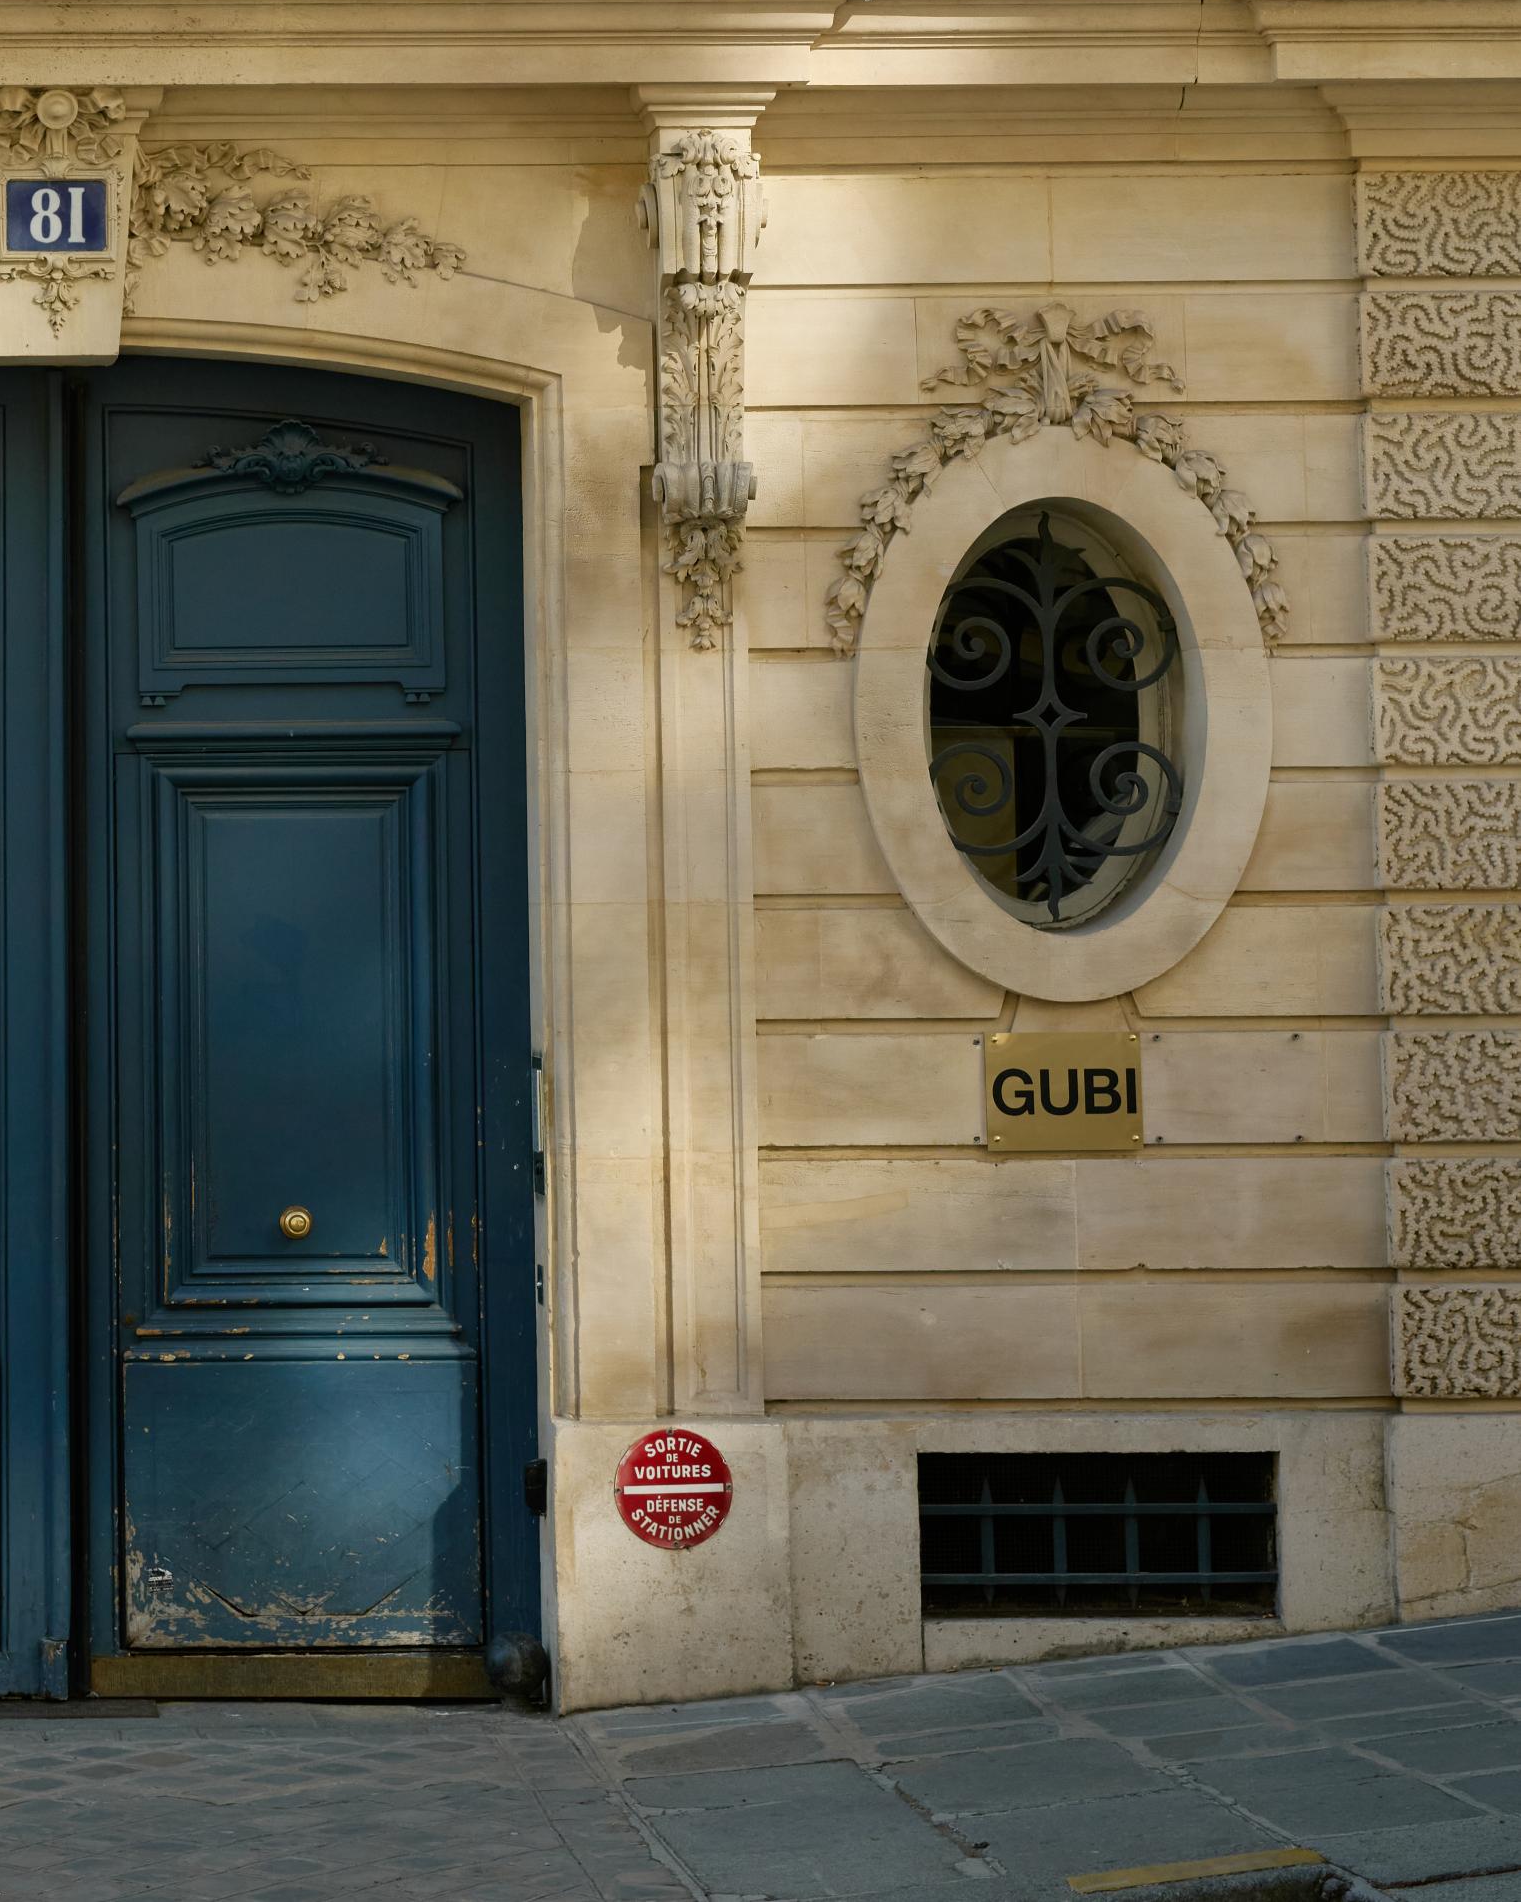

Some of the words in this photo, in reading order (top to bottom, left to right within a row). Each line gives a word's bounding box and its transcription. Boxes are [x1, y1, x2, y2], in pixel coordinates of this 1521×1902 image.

[30, 187, 86, 243] 81
[993, 1068, 1137, 1116] GUBI
[645, 1437, 702, 1457] SORTIE
[666, 1453, 678, 1463] DE
[634, 1464, 711, 1480] VOITURES
[631, 1505, 720, 1540] STATIONNER
[669, 1516, 681, 1524] DE
